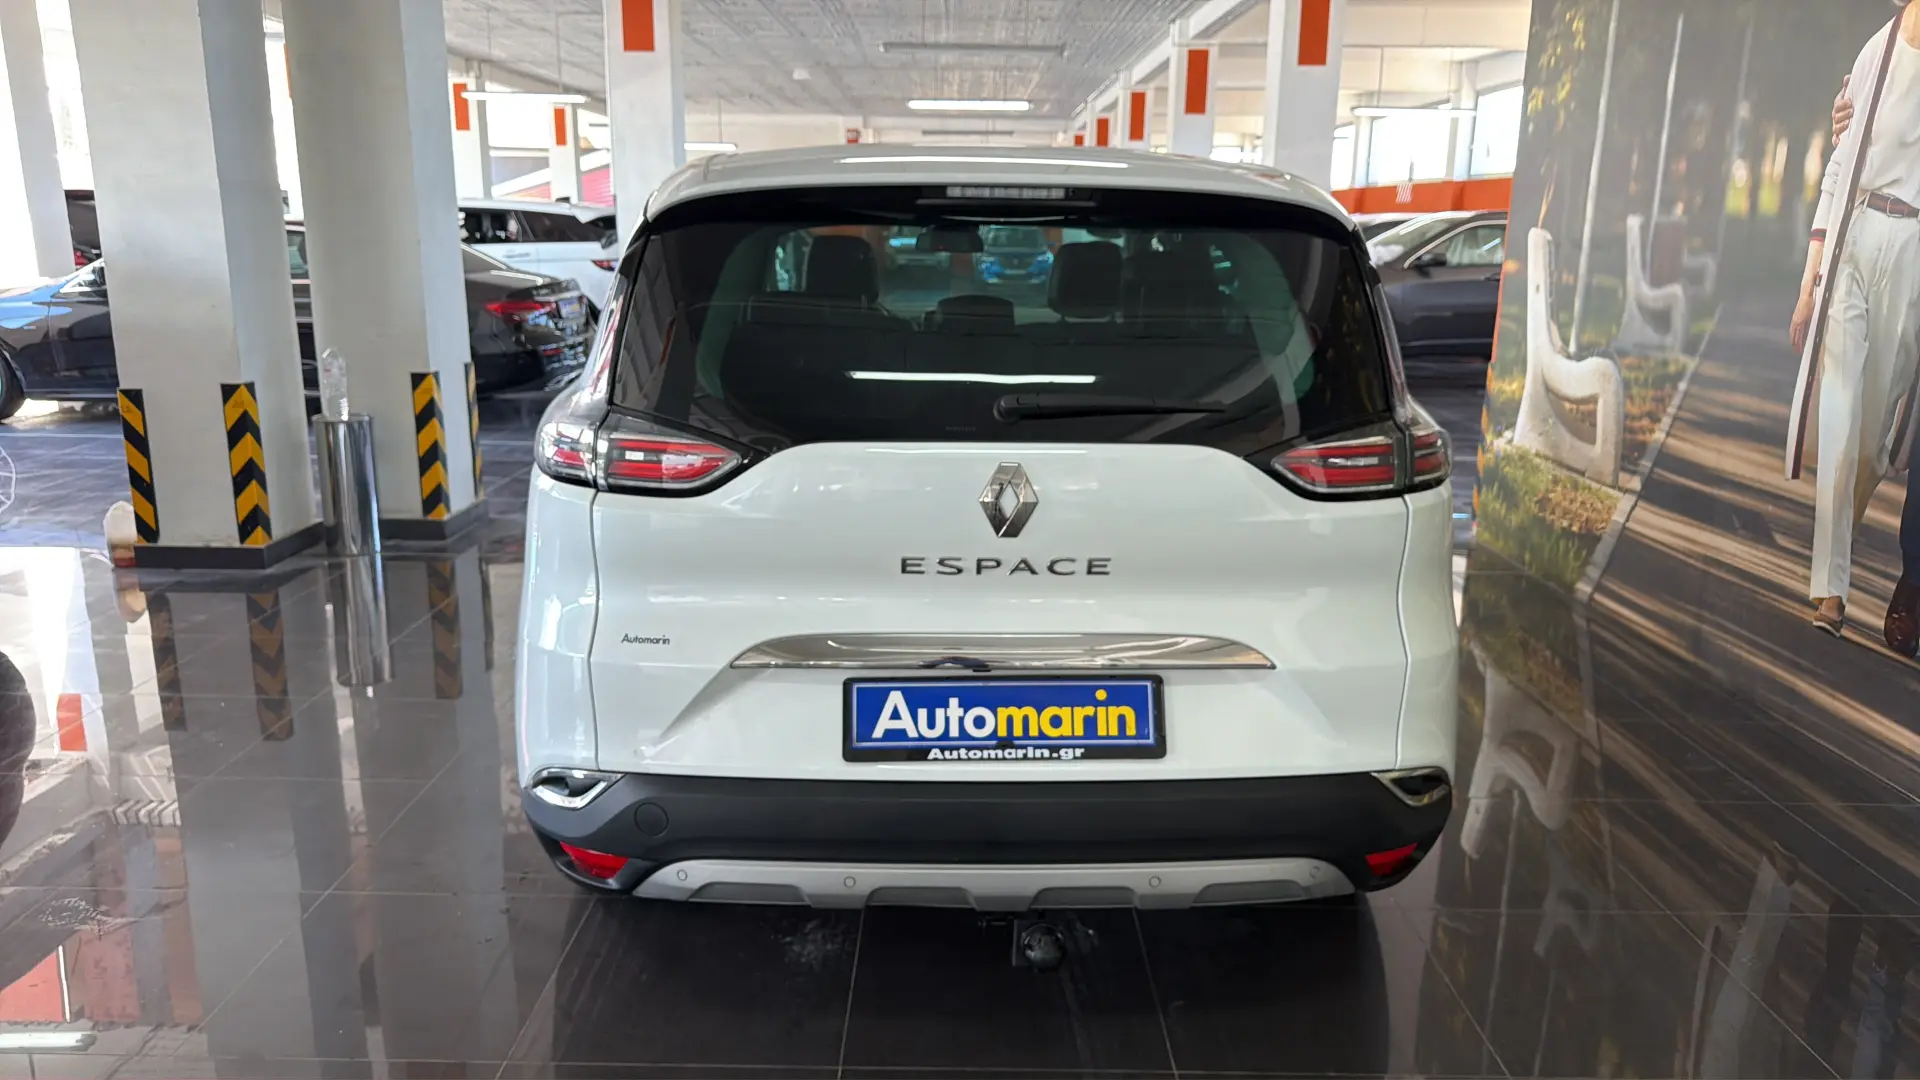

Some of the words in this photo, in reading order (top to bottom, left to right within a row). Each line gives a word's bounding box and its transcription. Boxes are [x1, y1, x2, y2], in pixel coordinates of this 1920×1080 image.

[901, 557, 1112, 576] ESPACE
[621, 633, 670, 645] Automarin
[871, 689, 1136, 738] Automarin
[927, 746, 1085, 761] Automarin.gr
